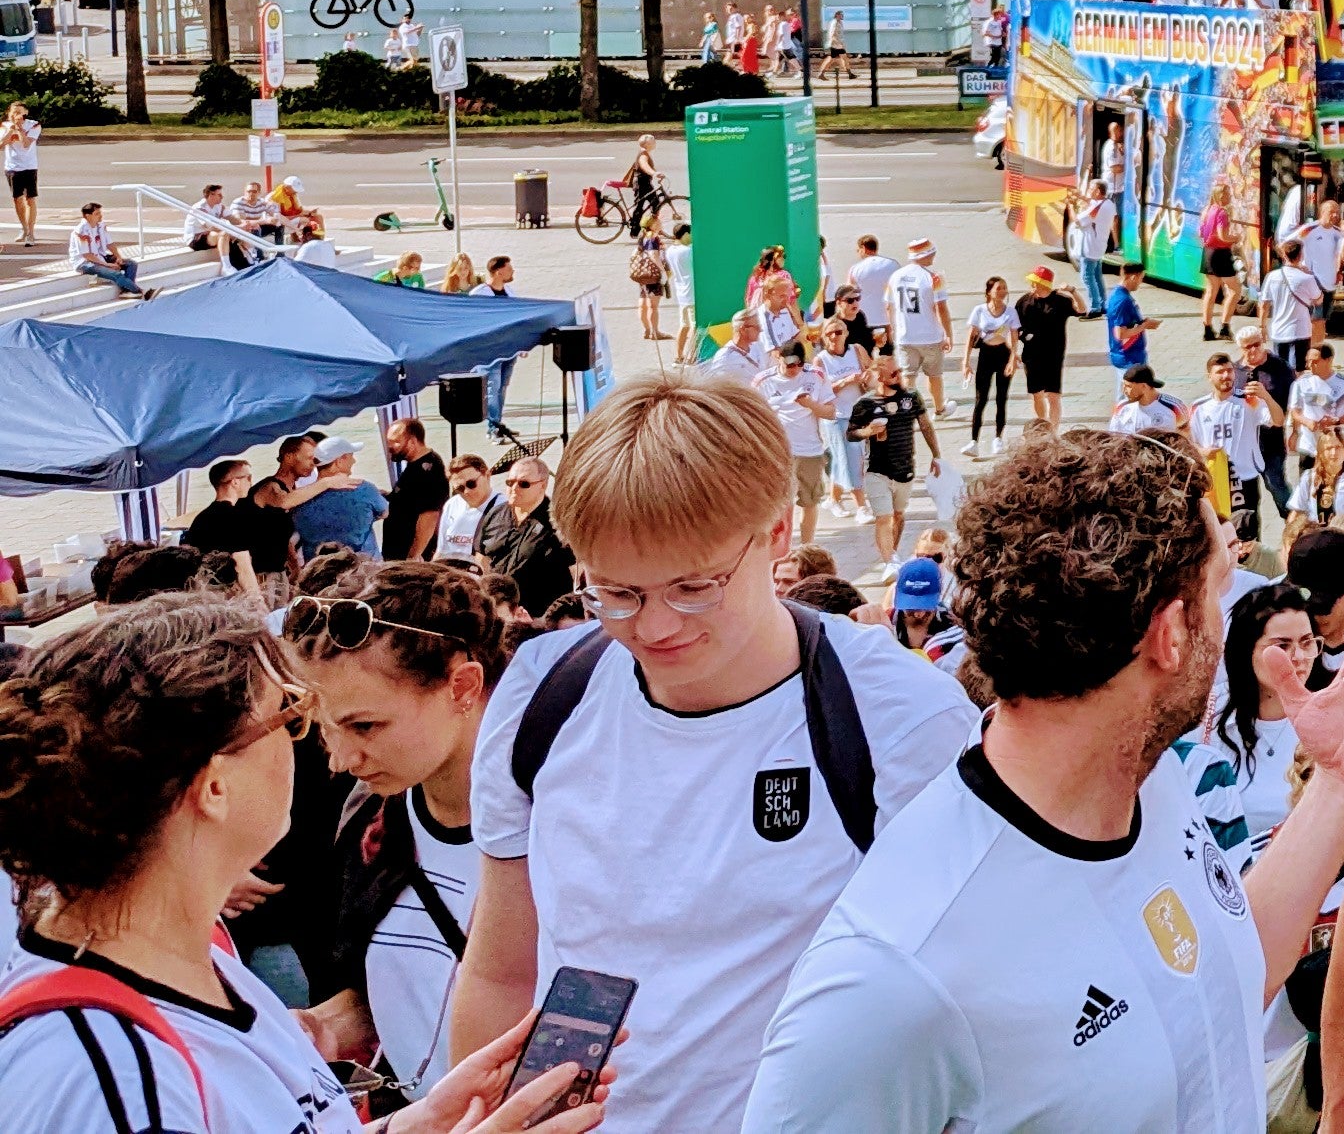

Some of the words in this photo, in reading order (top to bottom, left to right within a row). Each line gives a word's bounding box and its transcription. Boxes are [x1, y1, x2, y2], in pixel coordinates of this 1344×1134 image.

[1074, 11, 1139, 54] GERMAN
[1143, 16, 1168, 58] EM
[1172, 17, 1210, 64] BUS
[1212, 19, 1265, 67] 2024
[966, 74, 984, 82] DAS
[897, 286, 920, 313] 13
[1214, 424, 1233, 439] 26
[765, 777, 798, 794] DEUT
[765, 795, 791, 812] SCH
[764, 810, 800, 829] LAND
[1173, 938, 1192, 958] FIFA
[1073, 999, 1129, 1047] adidas
